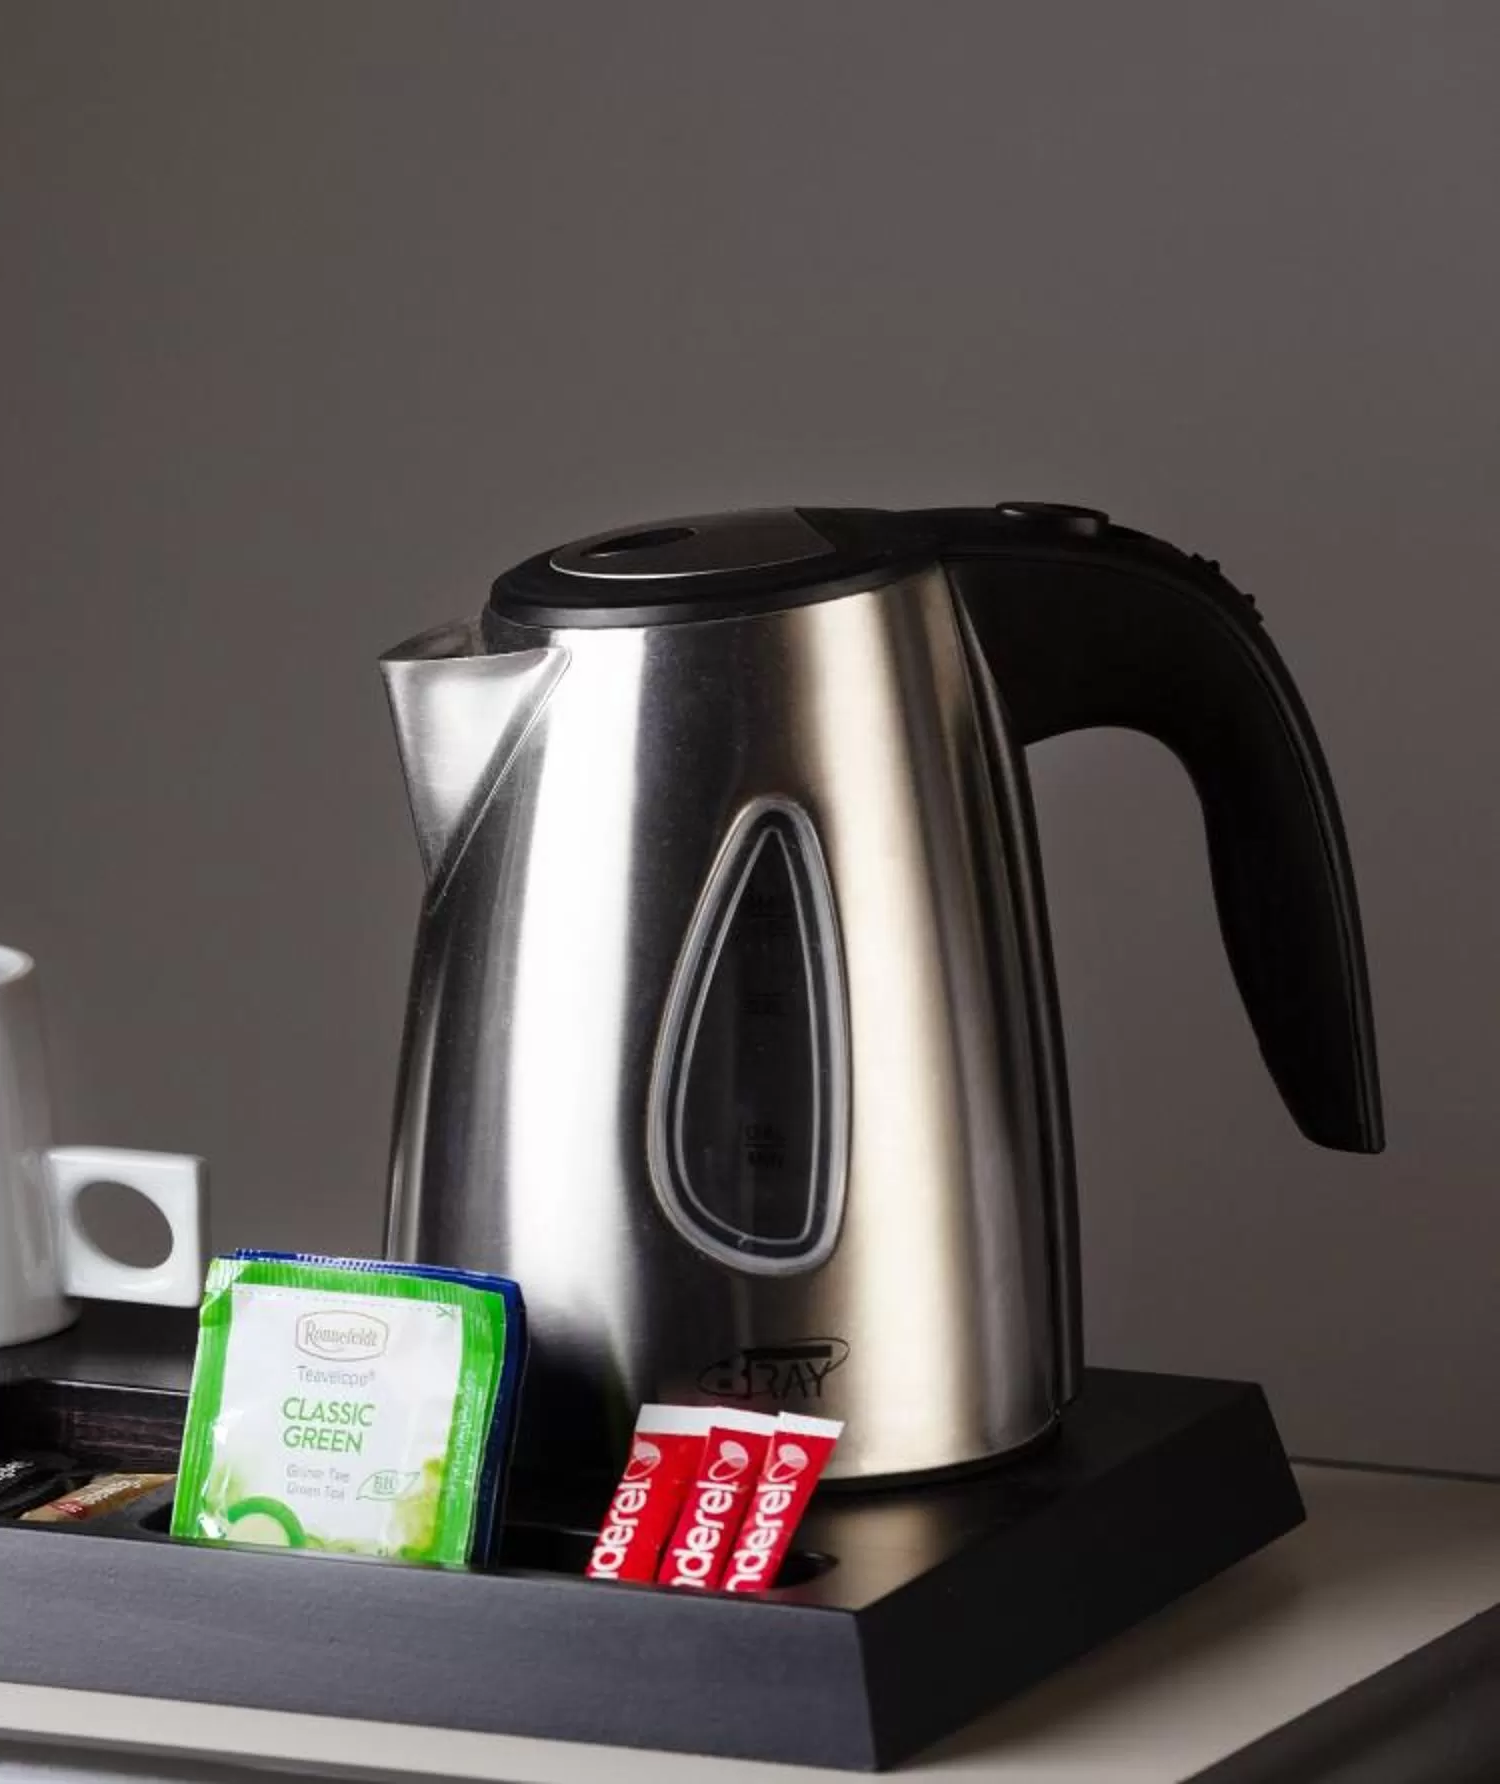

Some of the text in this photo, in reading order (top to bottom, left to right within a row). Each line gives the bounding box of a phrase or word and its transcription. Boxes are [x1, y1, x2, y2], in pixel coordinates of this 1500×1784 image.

[282, 1395, 377, 1428] CLASSIC
[283, 1425, 364, 1455] GREEN
[588, 1478, 652, 1579] derel
